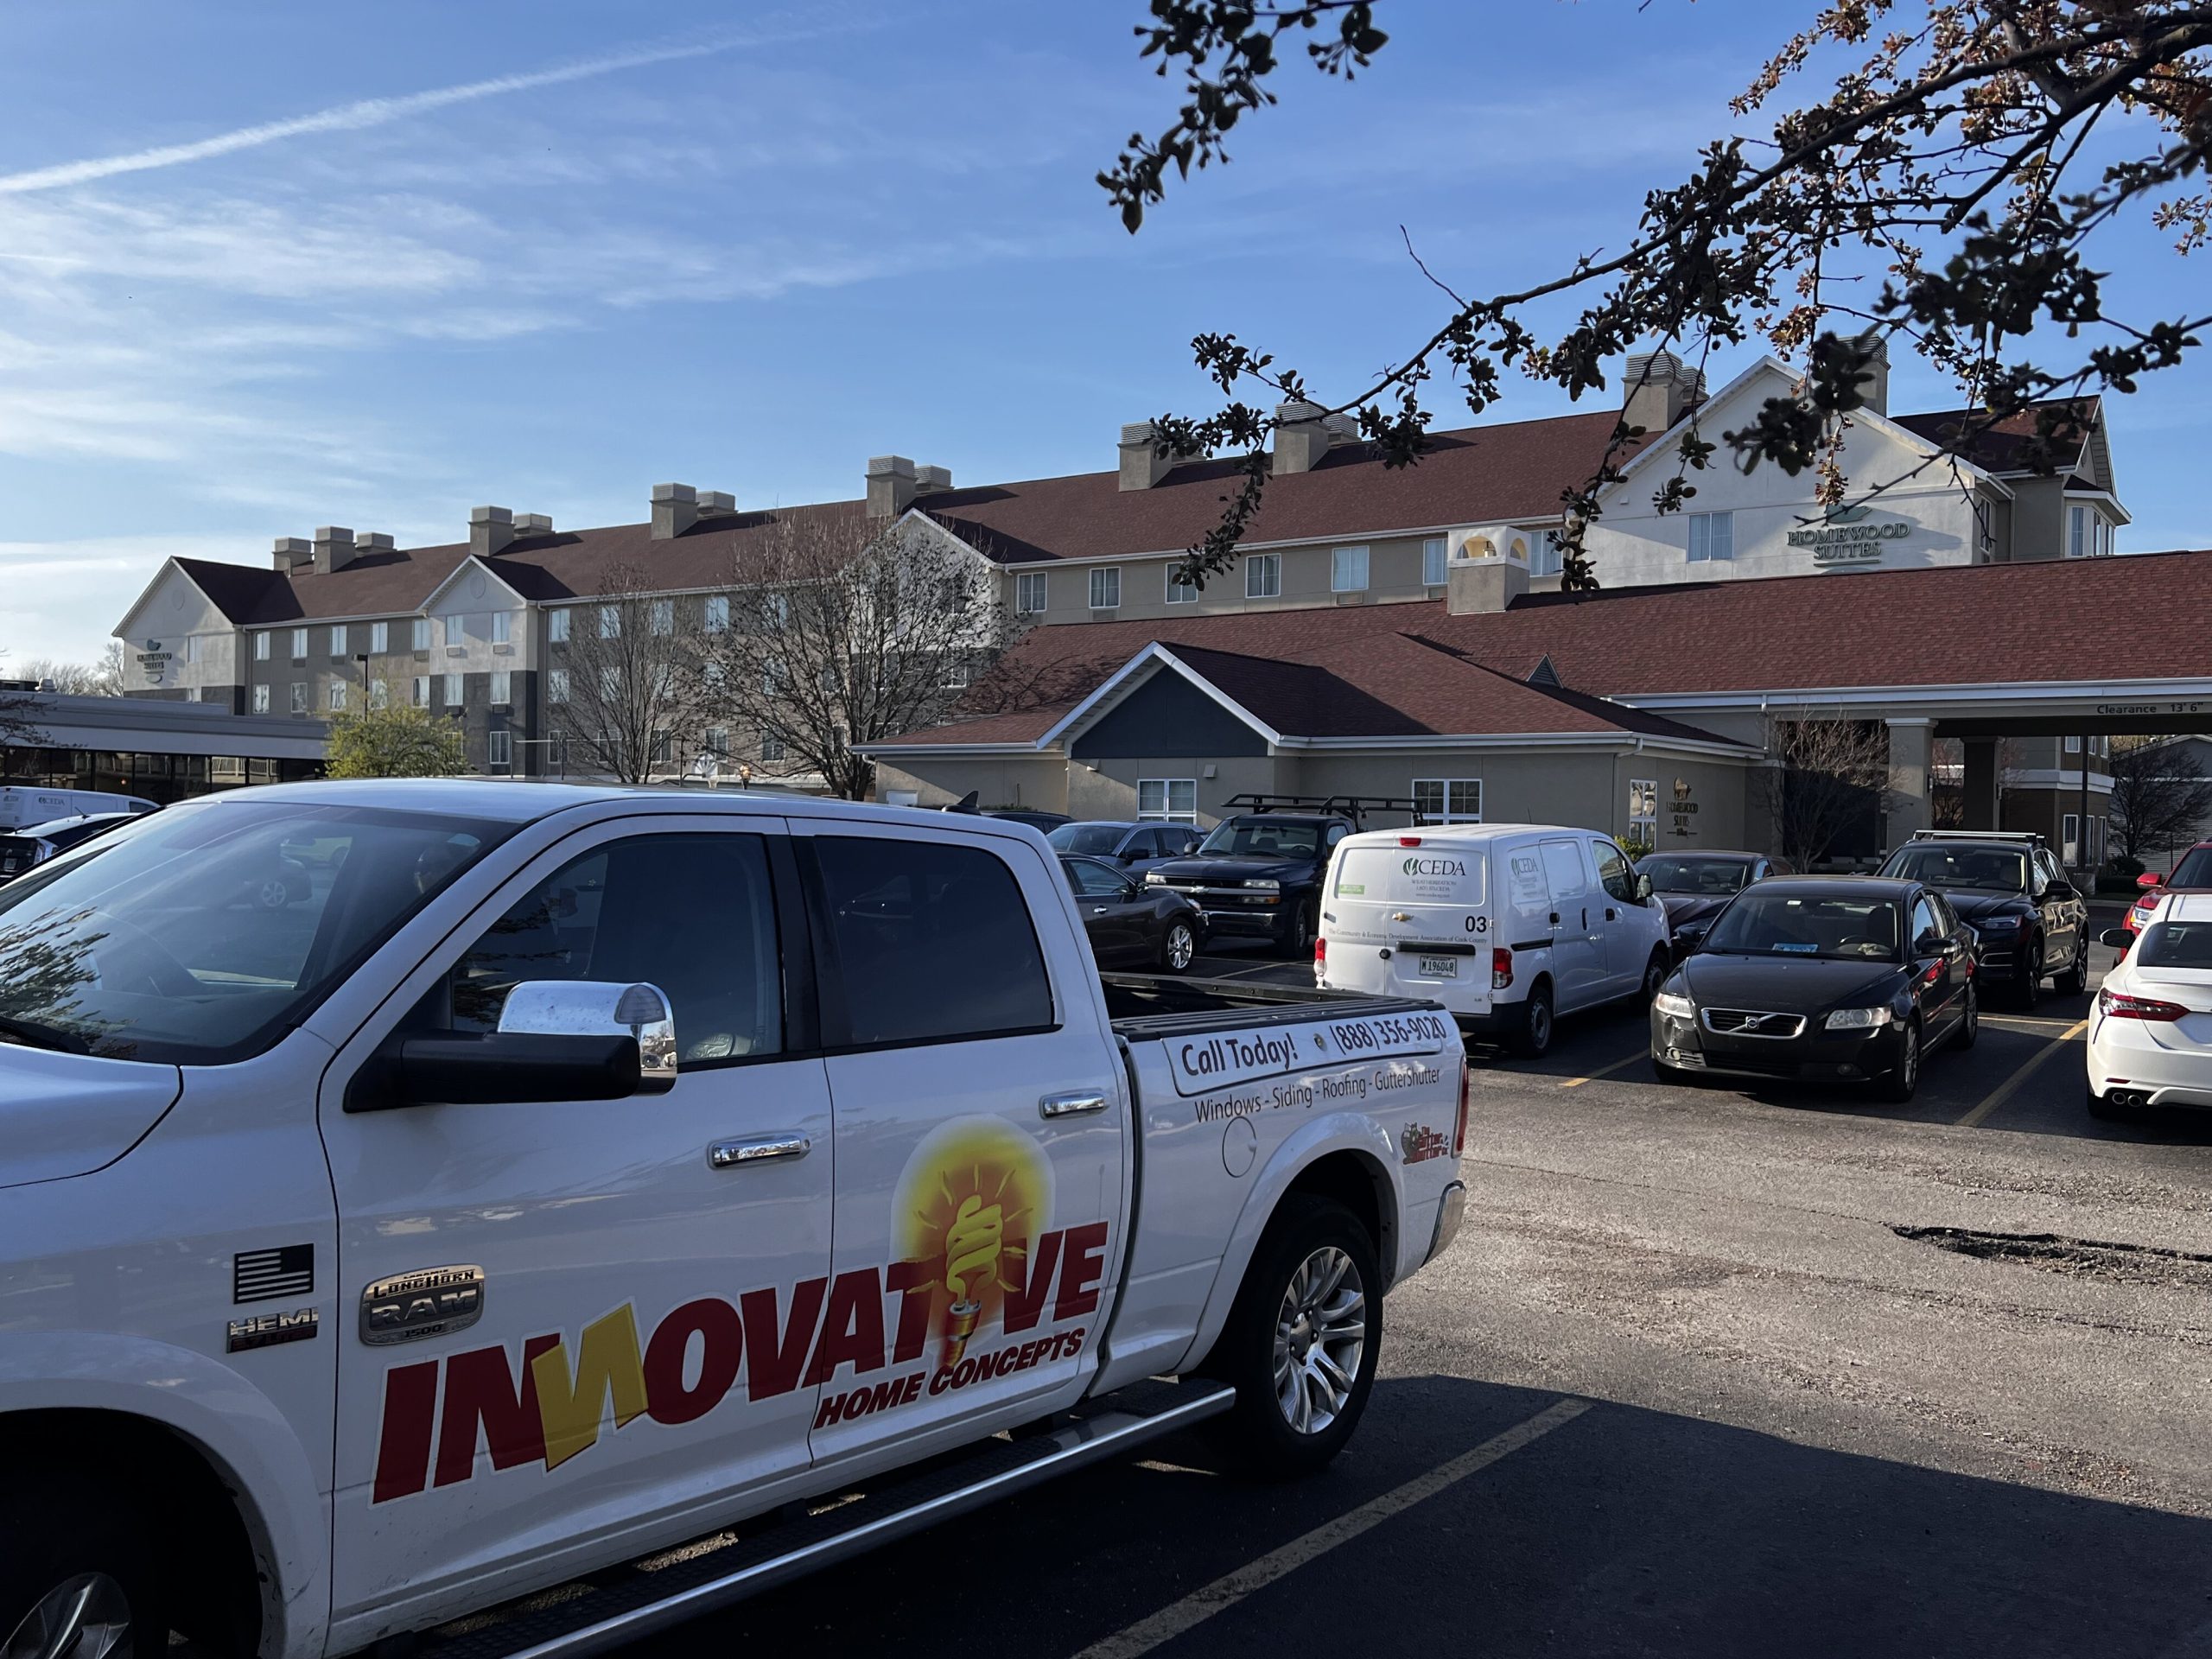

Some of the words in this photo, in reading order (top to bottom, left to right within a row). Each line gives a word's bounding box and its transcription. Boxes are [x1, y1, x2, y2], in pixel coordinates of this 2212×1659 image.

[1787, 523, 1910, 546] HOMEWOOD
[1814, 541, 1881, 560] SUITES
[2096, 704, 2157, 714] Clearance
[2170, 702, 2186, 713] 13'
[1419, 860, 1465, 876] CEDA
[1517, 857, 1538, 873] CEDA
[1465, 916, 1487, 932] 03
[1389, 932, 1419, 942] Development
[1427, 960, 1454, 972] 196048
[1329, 1021, 1380, 1056] (888)
[1374, 1016, 1446, 1045] 356-9020
[1182, 1039, 1226, 1076] Call
[1225, 1033, 1299, 1071] Today!
[1194, 1094, 1262, 1122] Windows
[1273, 1084, 1313, 1109] Siding
[1322, 1074, 1367, 1098] Roofing
[1375, 1066, 1440, 1090] GutterShutter
[371, 1288, 477, 1326] RAM
[227, 1306, 318, 1336] HEMI
[404, 1322, 443, 1338] 1500
[813, 1370, 926, 1430] HOME
[929, 1327, 1086, 1395] CONCEPTS
